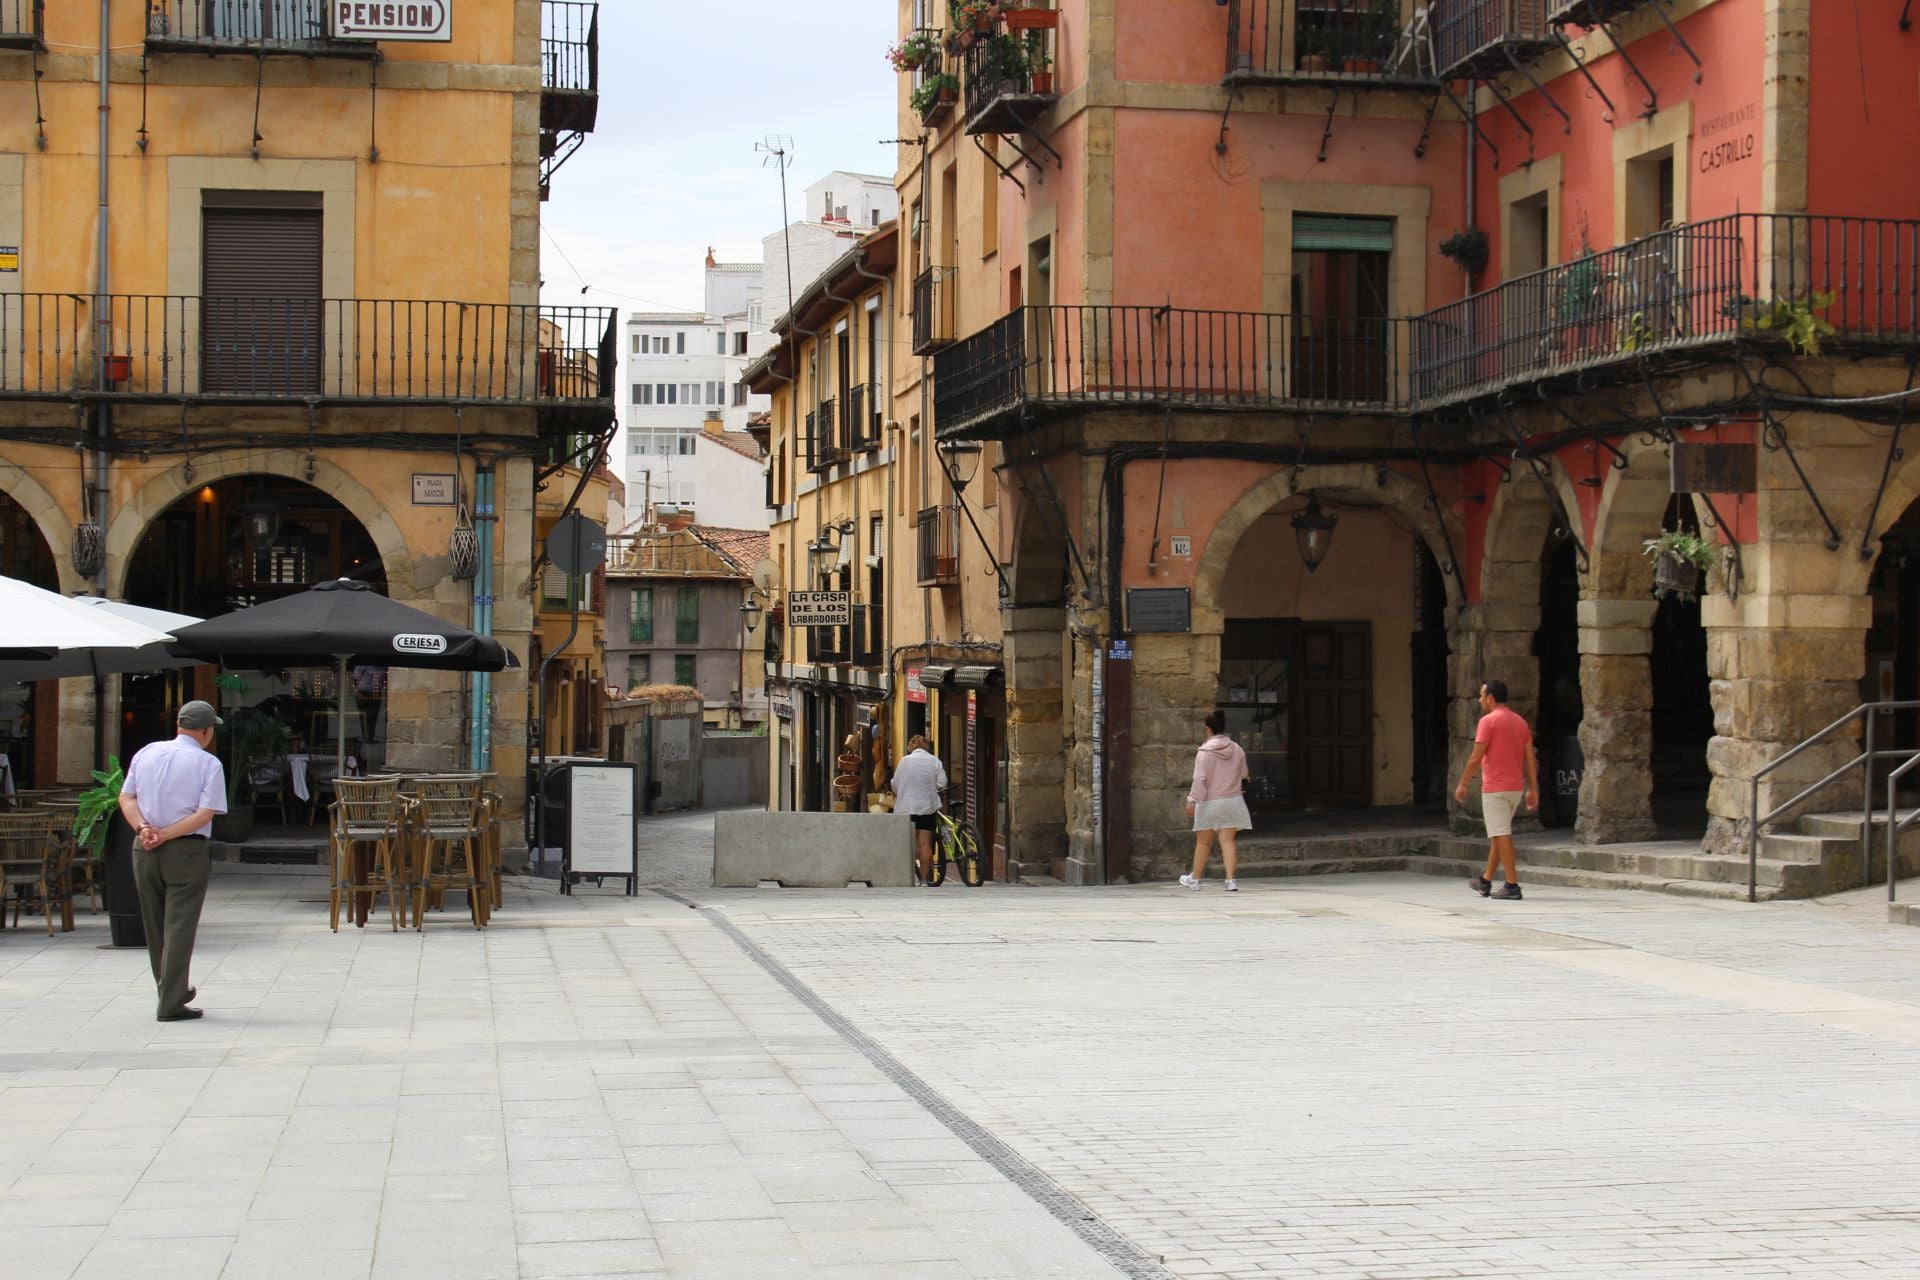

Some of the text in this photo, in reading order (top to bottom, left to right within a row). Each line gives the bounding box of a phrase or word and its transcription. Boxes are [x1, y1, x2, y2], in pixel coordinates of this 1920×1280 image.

[339, 3, 433, 27] PENSION
[1701, 102, 1756, 138] RESTAURANTE
[1700, 133, 1754, 174] CASTRILLO
[424, 490, 445, 498] MAYOR
[791, 592, 847, 603] LA CASA
[791, 603, 847, 613] DE LOS
[792, 614, 847, 624] LABRADORES
